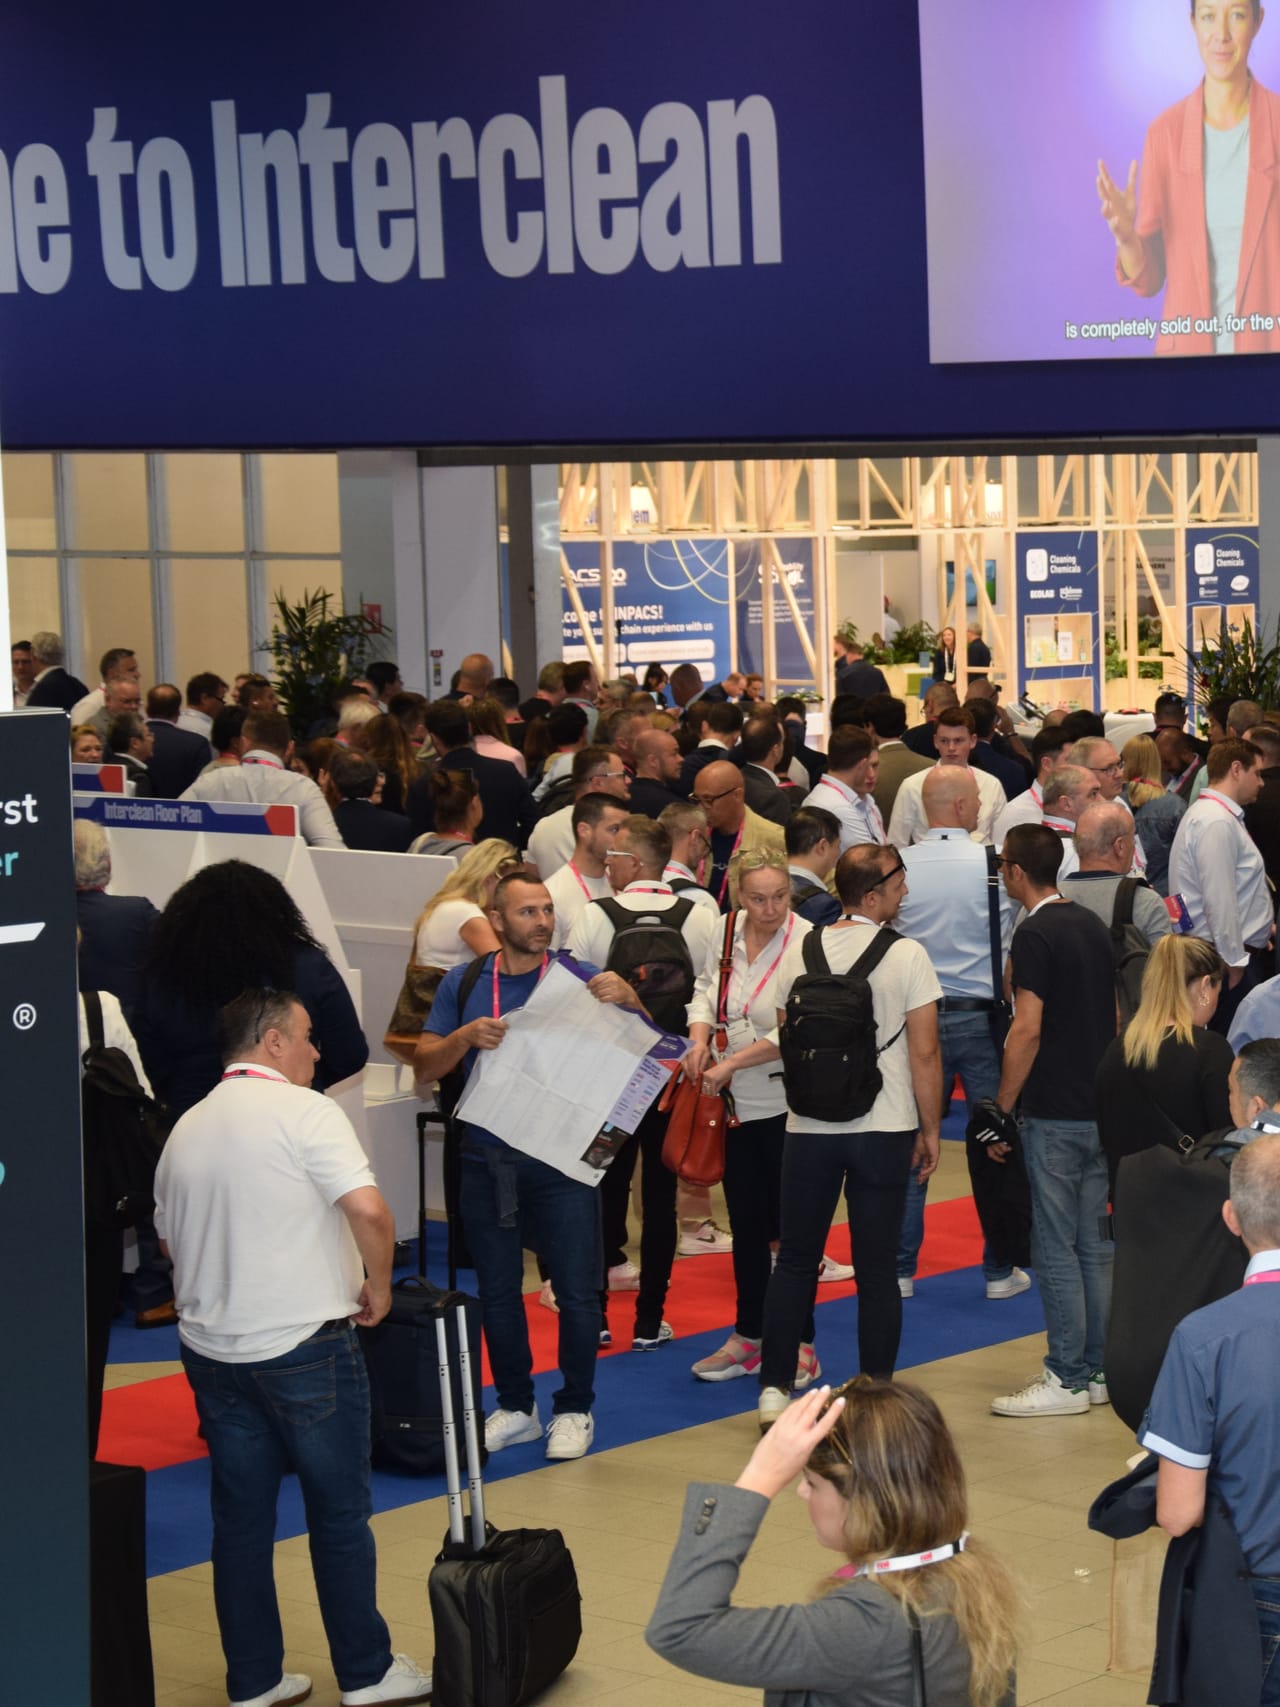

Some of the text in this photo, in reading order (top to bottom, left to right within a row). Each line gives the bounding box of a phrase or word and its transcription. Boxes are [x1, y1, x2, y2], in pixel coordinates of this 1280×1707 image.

[86, 107, 198, 291] to
[211, 74, 782, 288] Interclean
[1066, 322, 1077, 338] is
[1081, 319, 1156, 340] completely
[1160, 317, 1190, 335] sold
[1194, 316, 1222, 336] out,
[1225, 314, 1247, 332] for
[1250, 313, 1274, 331] the
[1050, 553, 1077, 566] Cleaning
[1216, 548, 1241, 559] Cleaning
[1050, 564, 1081, 574] Chemicals
[1216, 558, 1245, 567] Chemicals
[614, 604, 664, 621] INPACS!
[621, 624, 641, 635] chain
[642, 622, 685, 636] experience
[685, 620, 702, 632] with
[703, 622, 713, 632] us
[0, 793, 39, 826] st
[103, 800, 203, 824] Interclean Floor Plan
[0, 851, 19, 876] r
